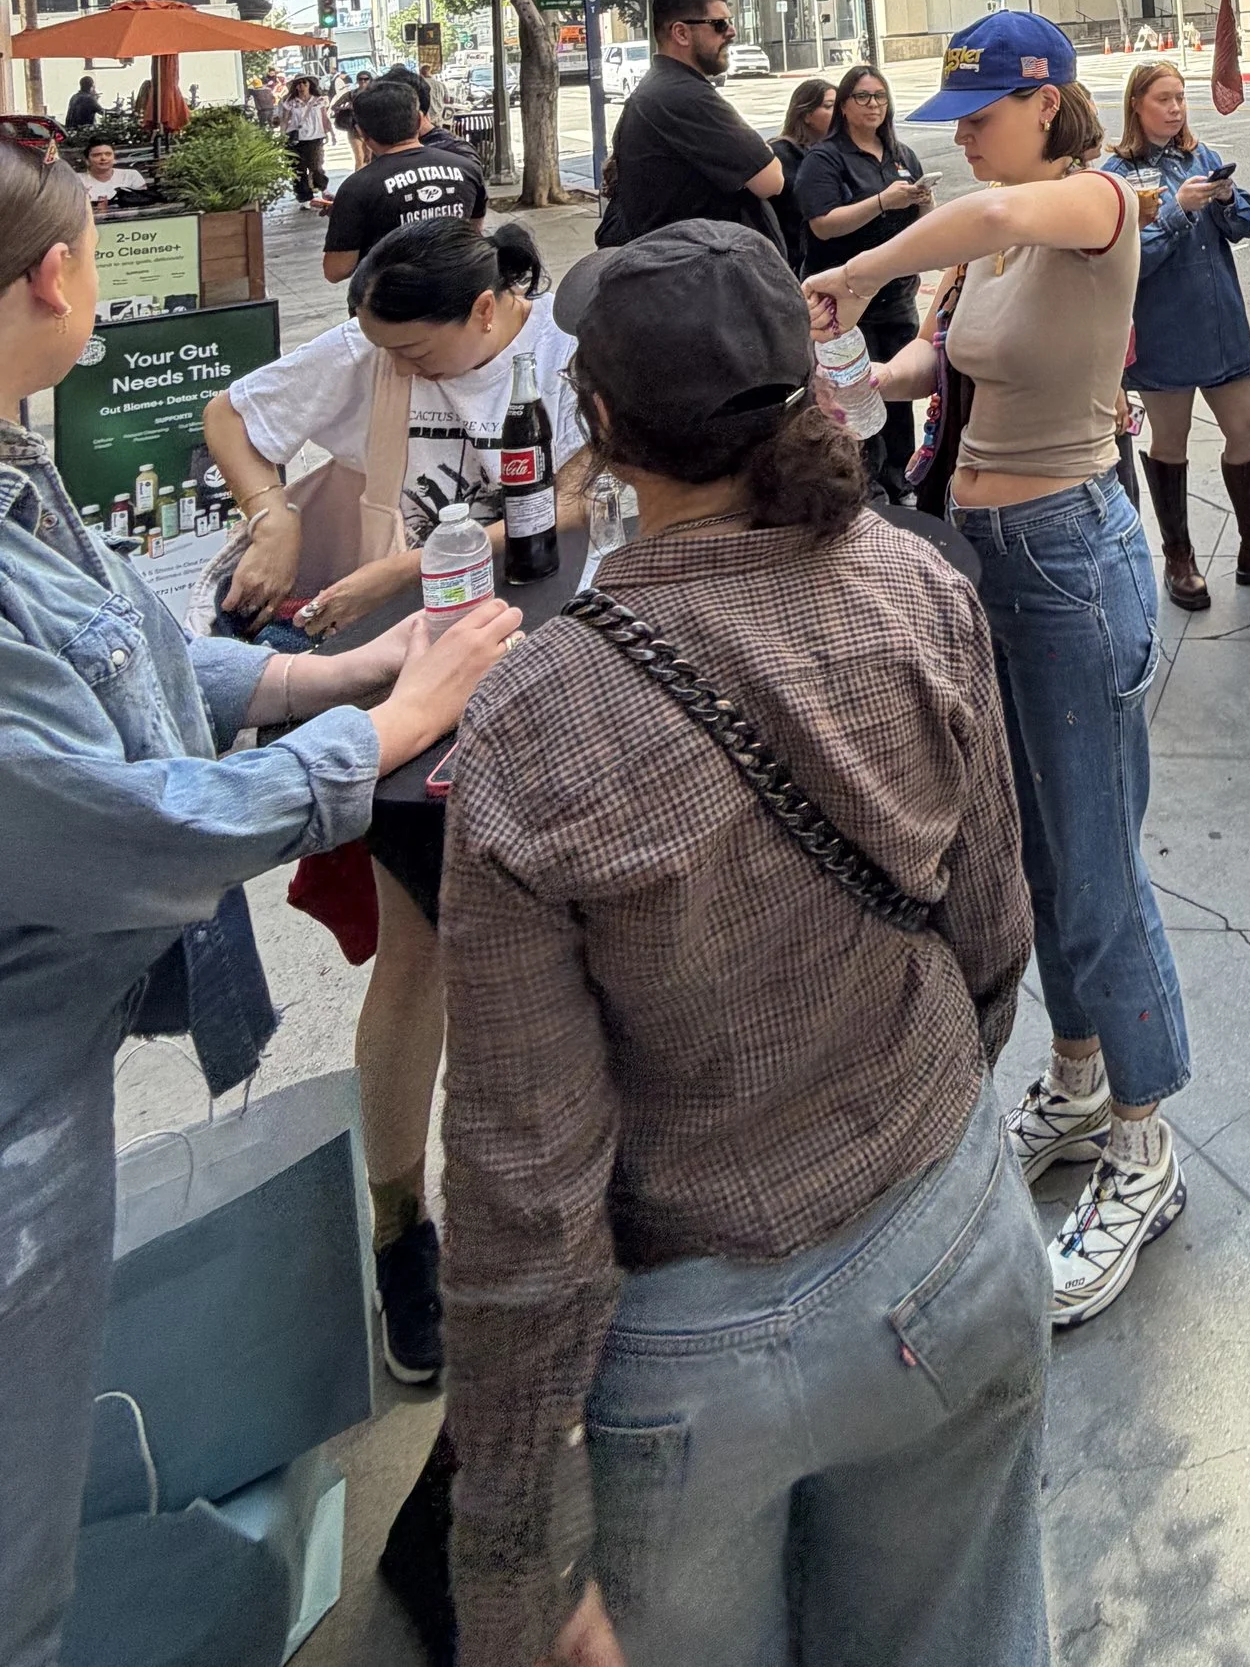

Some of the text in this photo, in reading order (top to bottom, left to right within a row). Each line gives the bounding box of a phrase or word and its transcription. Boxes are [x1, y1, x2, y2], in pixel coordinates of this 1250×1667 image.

[384, 165, 464, 194] PRO ITALIA
[400, 202, 464, 227] LOS ANGELES
[116, 231, 157, 243] 2-Day
[118, 244, 181, 257] Cleanse+
[124, 342, 219, 370] Your Gut
[112, 362, 231, 394] Needs This
[100, 406, 121, 416] Gut
[123, 399, 164, 413] Biome+
[166, 394, 198, 406] Detox
[409, 410, 454, 422] CACTUS
